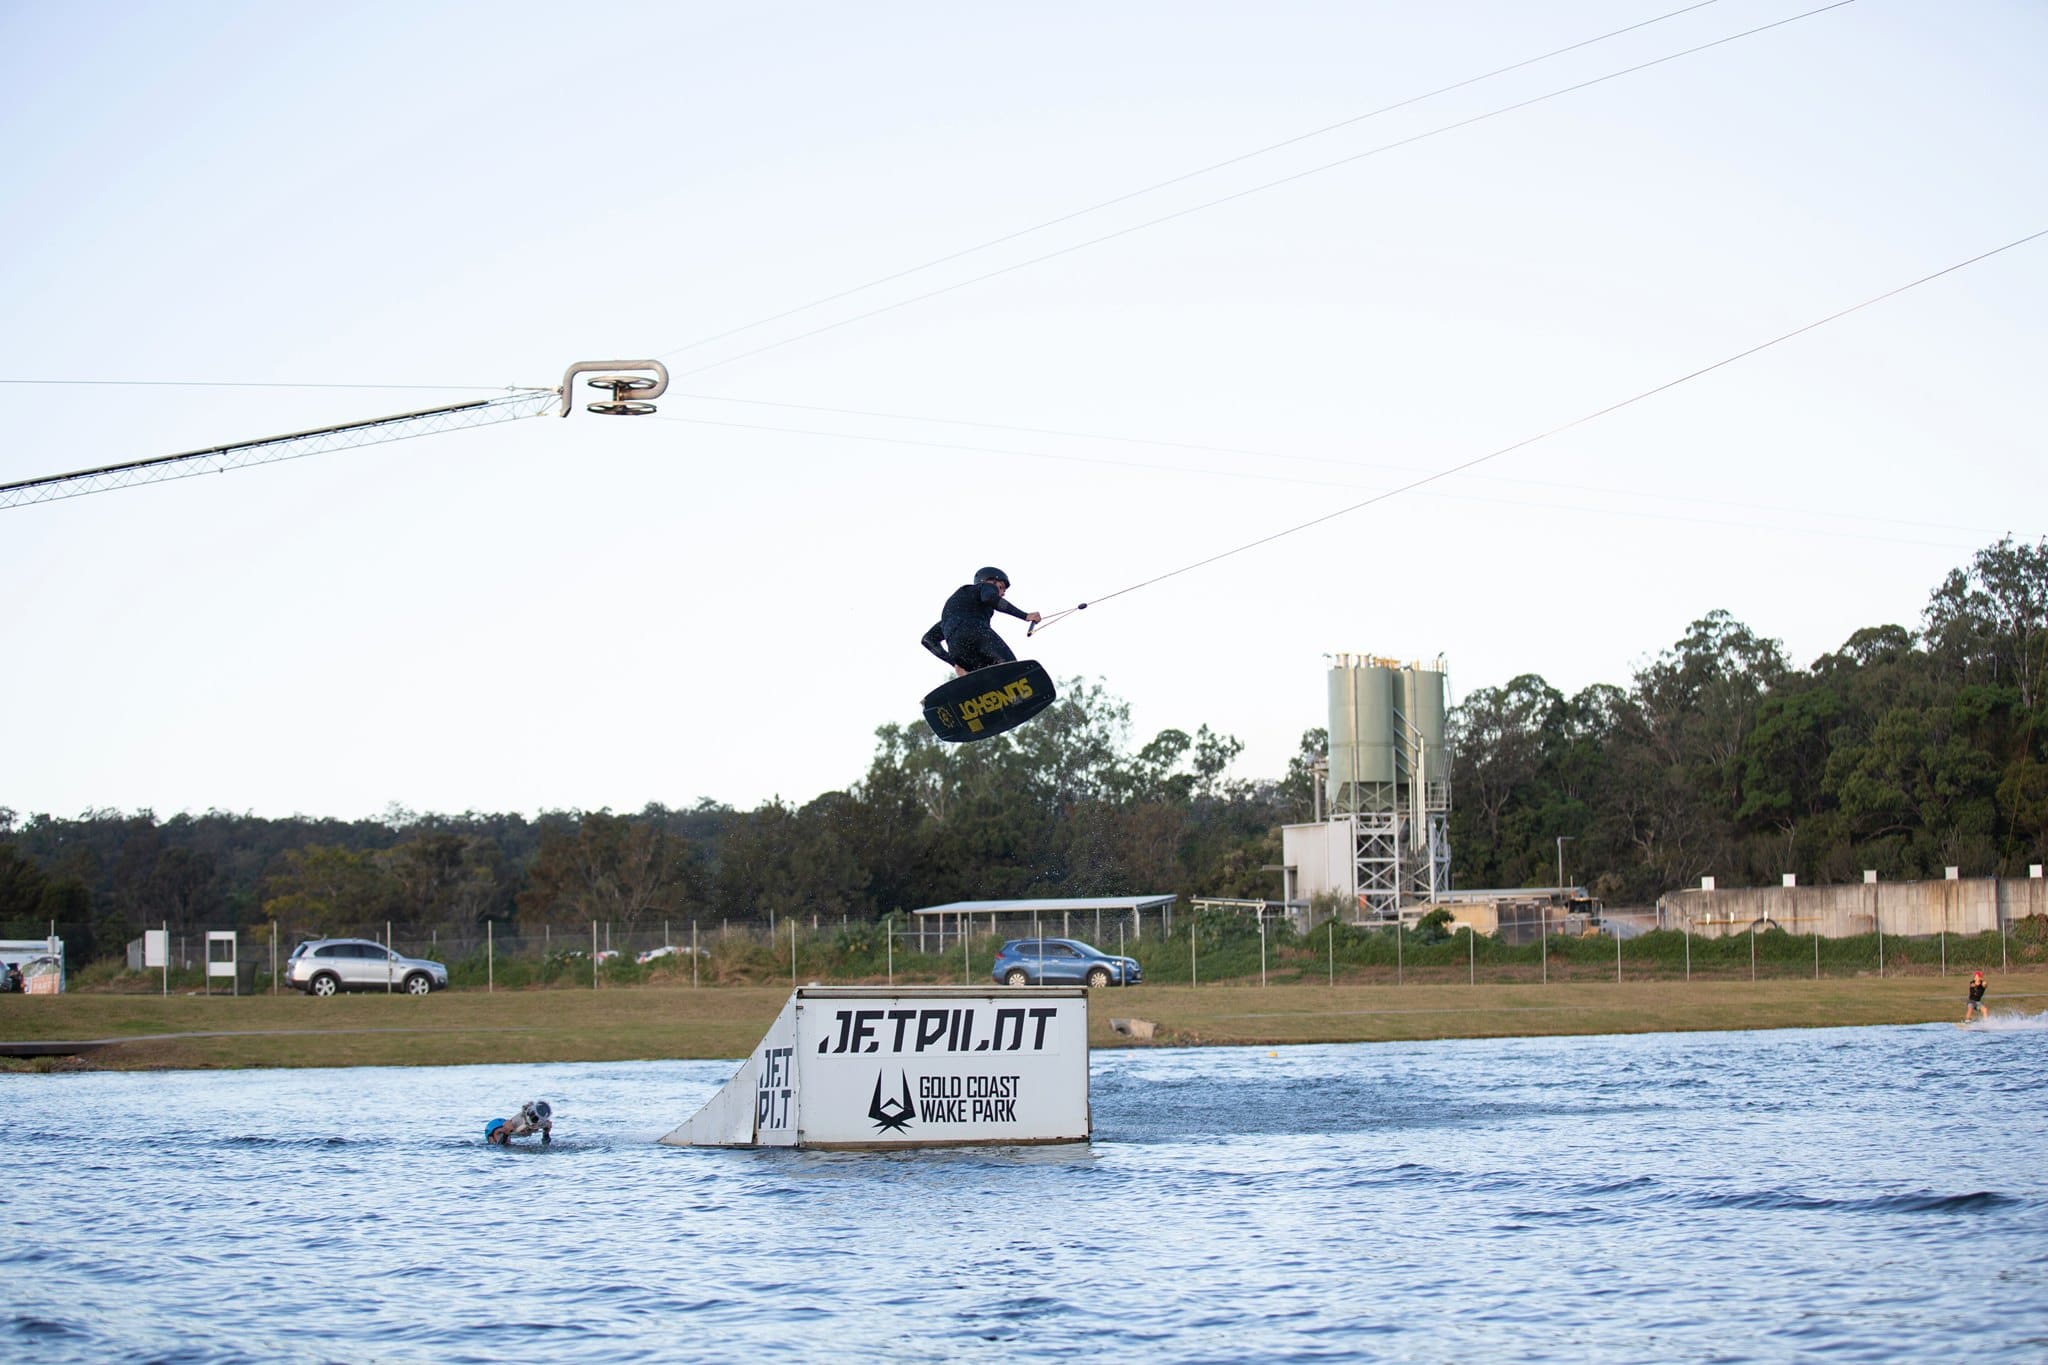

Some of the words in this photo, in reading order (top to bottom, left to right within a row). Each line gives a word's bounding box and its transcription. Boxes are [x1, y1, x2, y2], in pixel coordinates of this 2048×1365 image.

[958, 678, 1033, 721] SLINGSHOT
[818, 1008, 1058, 1054] JETPILOT
[760, 1047, 793, 1089] JET
[919, 1076, 961, 1098] GOLD
[966, 1075, 1021, 1098] COAST
[758, 1089, 792, 1129] PLT
[920, 1099, 967, 1123] WAKE
[972, 1099, 1018, 1122] PARK
